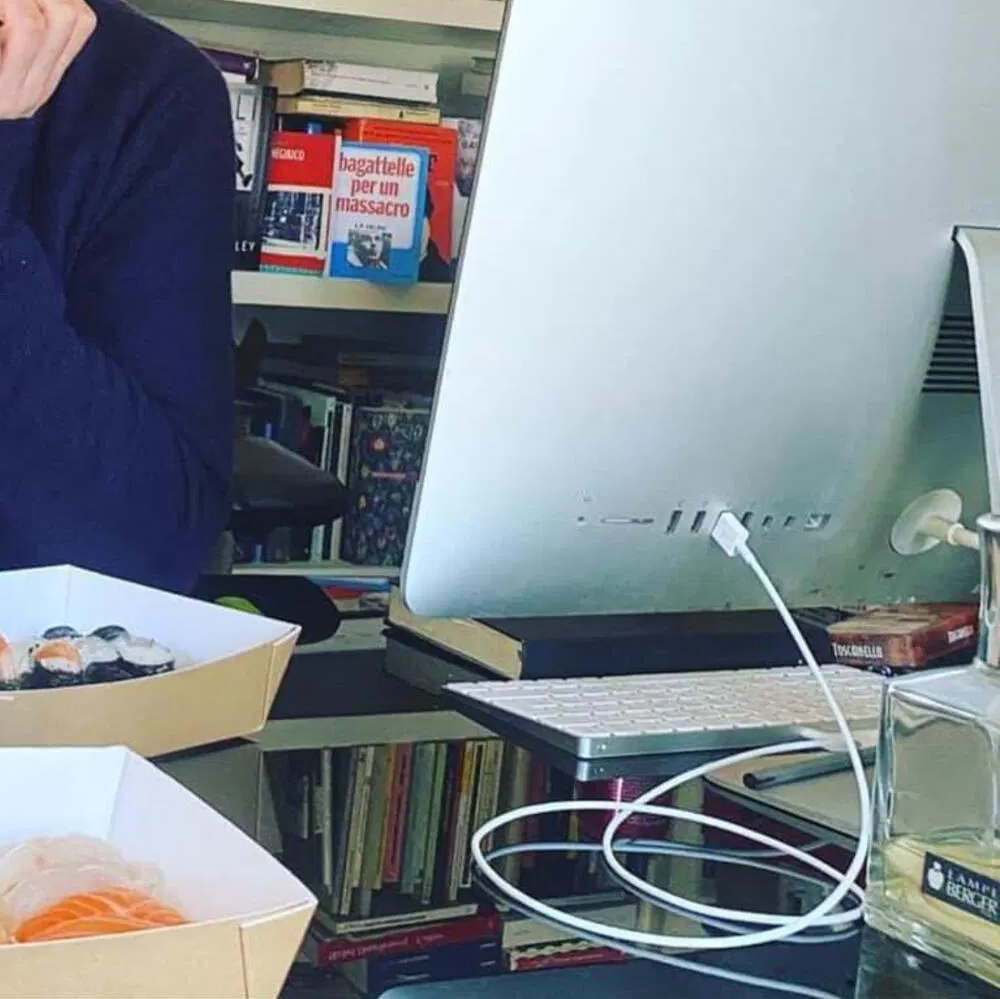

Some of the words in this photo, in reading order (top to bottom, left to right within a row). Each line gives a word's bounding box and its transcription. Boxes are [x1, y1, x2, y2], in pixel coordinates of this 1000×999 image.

[338, 152, 415, 178] bagattelle
[350, 178, 377, 197] per
[380, 182, 399, 197] un
[335, 197, 410, 218] massacro
[945, 880, 998, 916] BERGER
